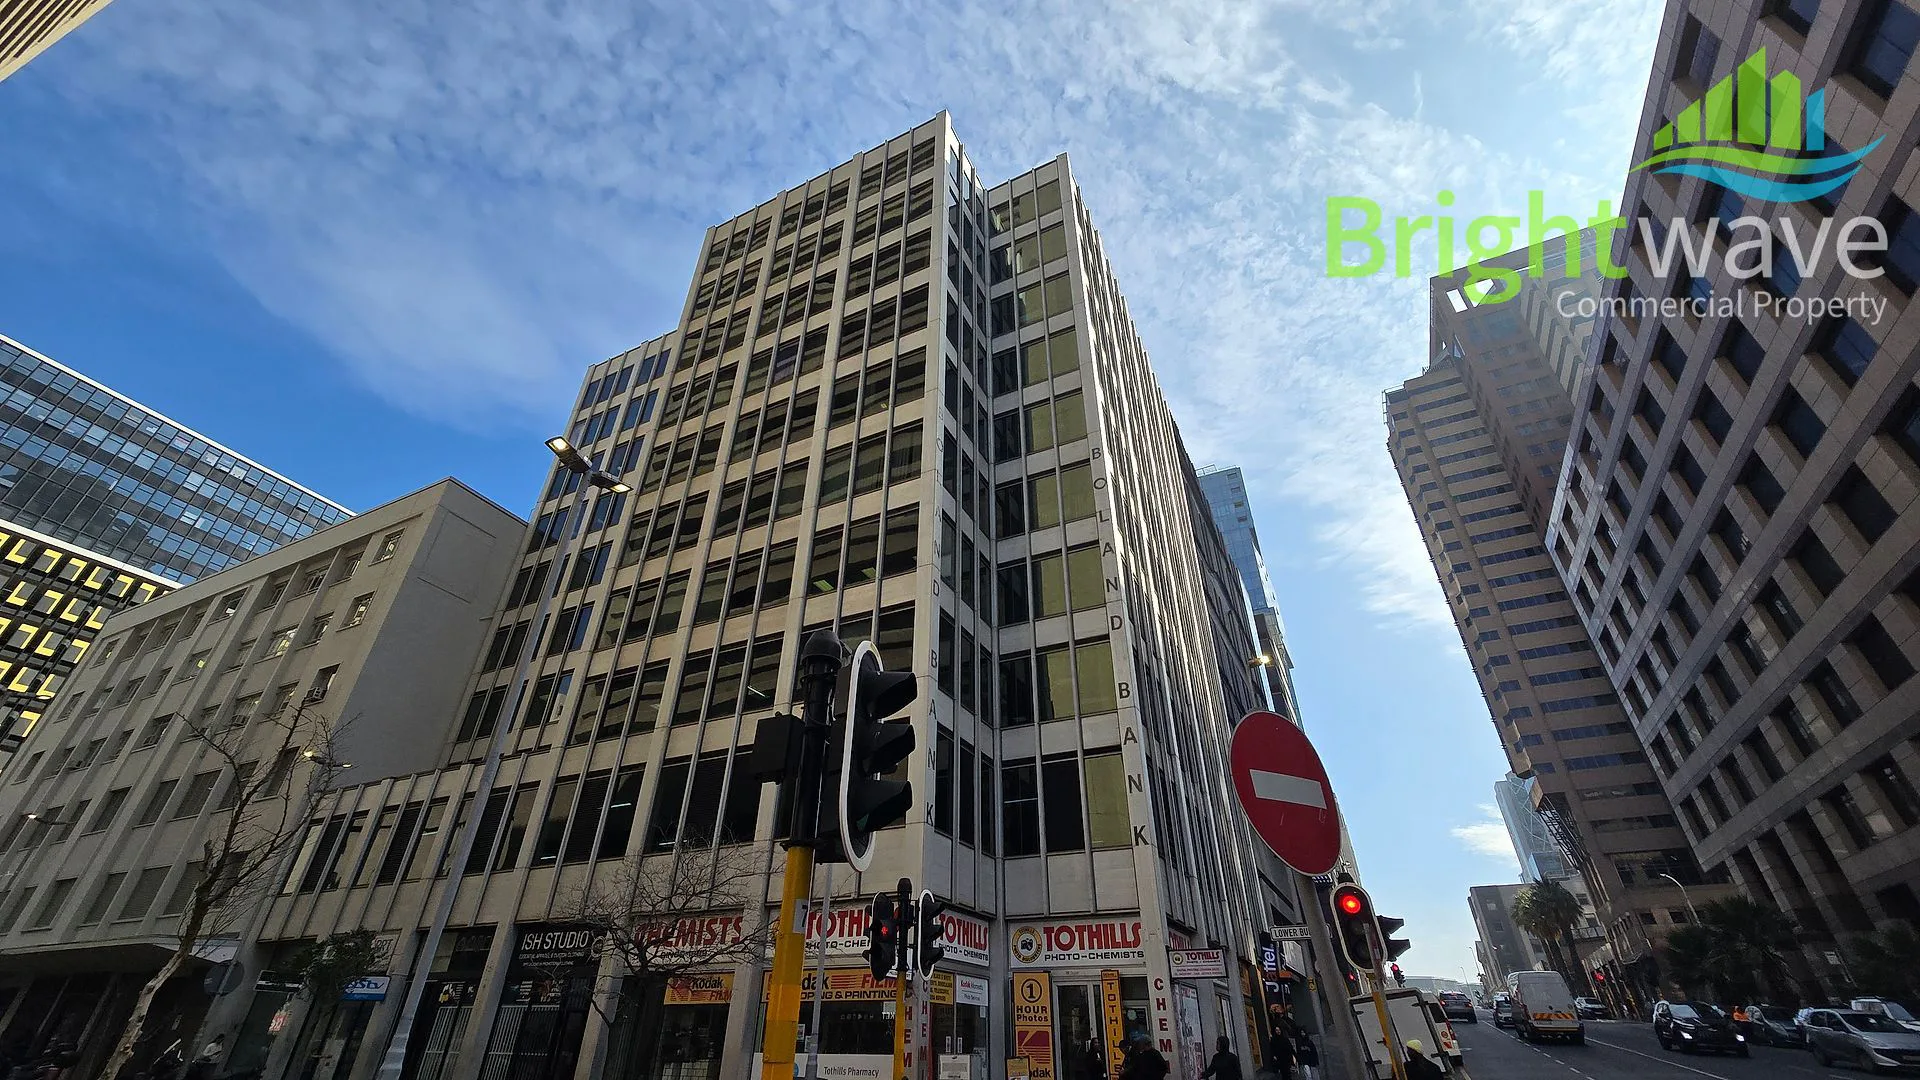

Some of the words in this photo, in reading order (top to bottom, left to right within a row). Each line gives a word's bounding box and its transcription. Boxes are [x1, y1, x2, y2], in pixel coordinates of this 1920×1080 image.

[1118, 681, 1150, 847] BANK
[1043, 922, 1142, 952] TOTHILLS
[1274, 928, 1298, 938] LOWER
[1300, 928, 1312, 938] BU
[521, 932, 544, 951] ISH
[543, 931, 590, 950] STUDIO
[1185, 951, 1221, 961] TOTHILLS
[692, 976, 724, 990] Kodak
[834, 990, 843, 999] &
[844, 989, 897, 999] PRINTING
[1026, 983, 1036, 999] 1
[1016, 1005, 1048, 1015] HOUR
[1016, 1014, 1049, 1023] Photos
[847, 1067, 880, 1078] Pharmacy
